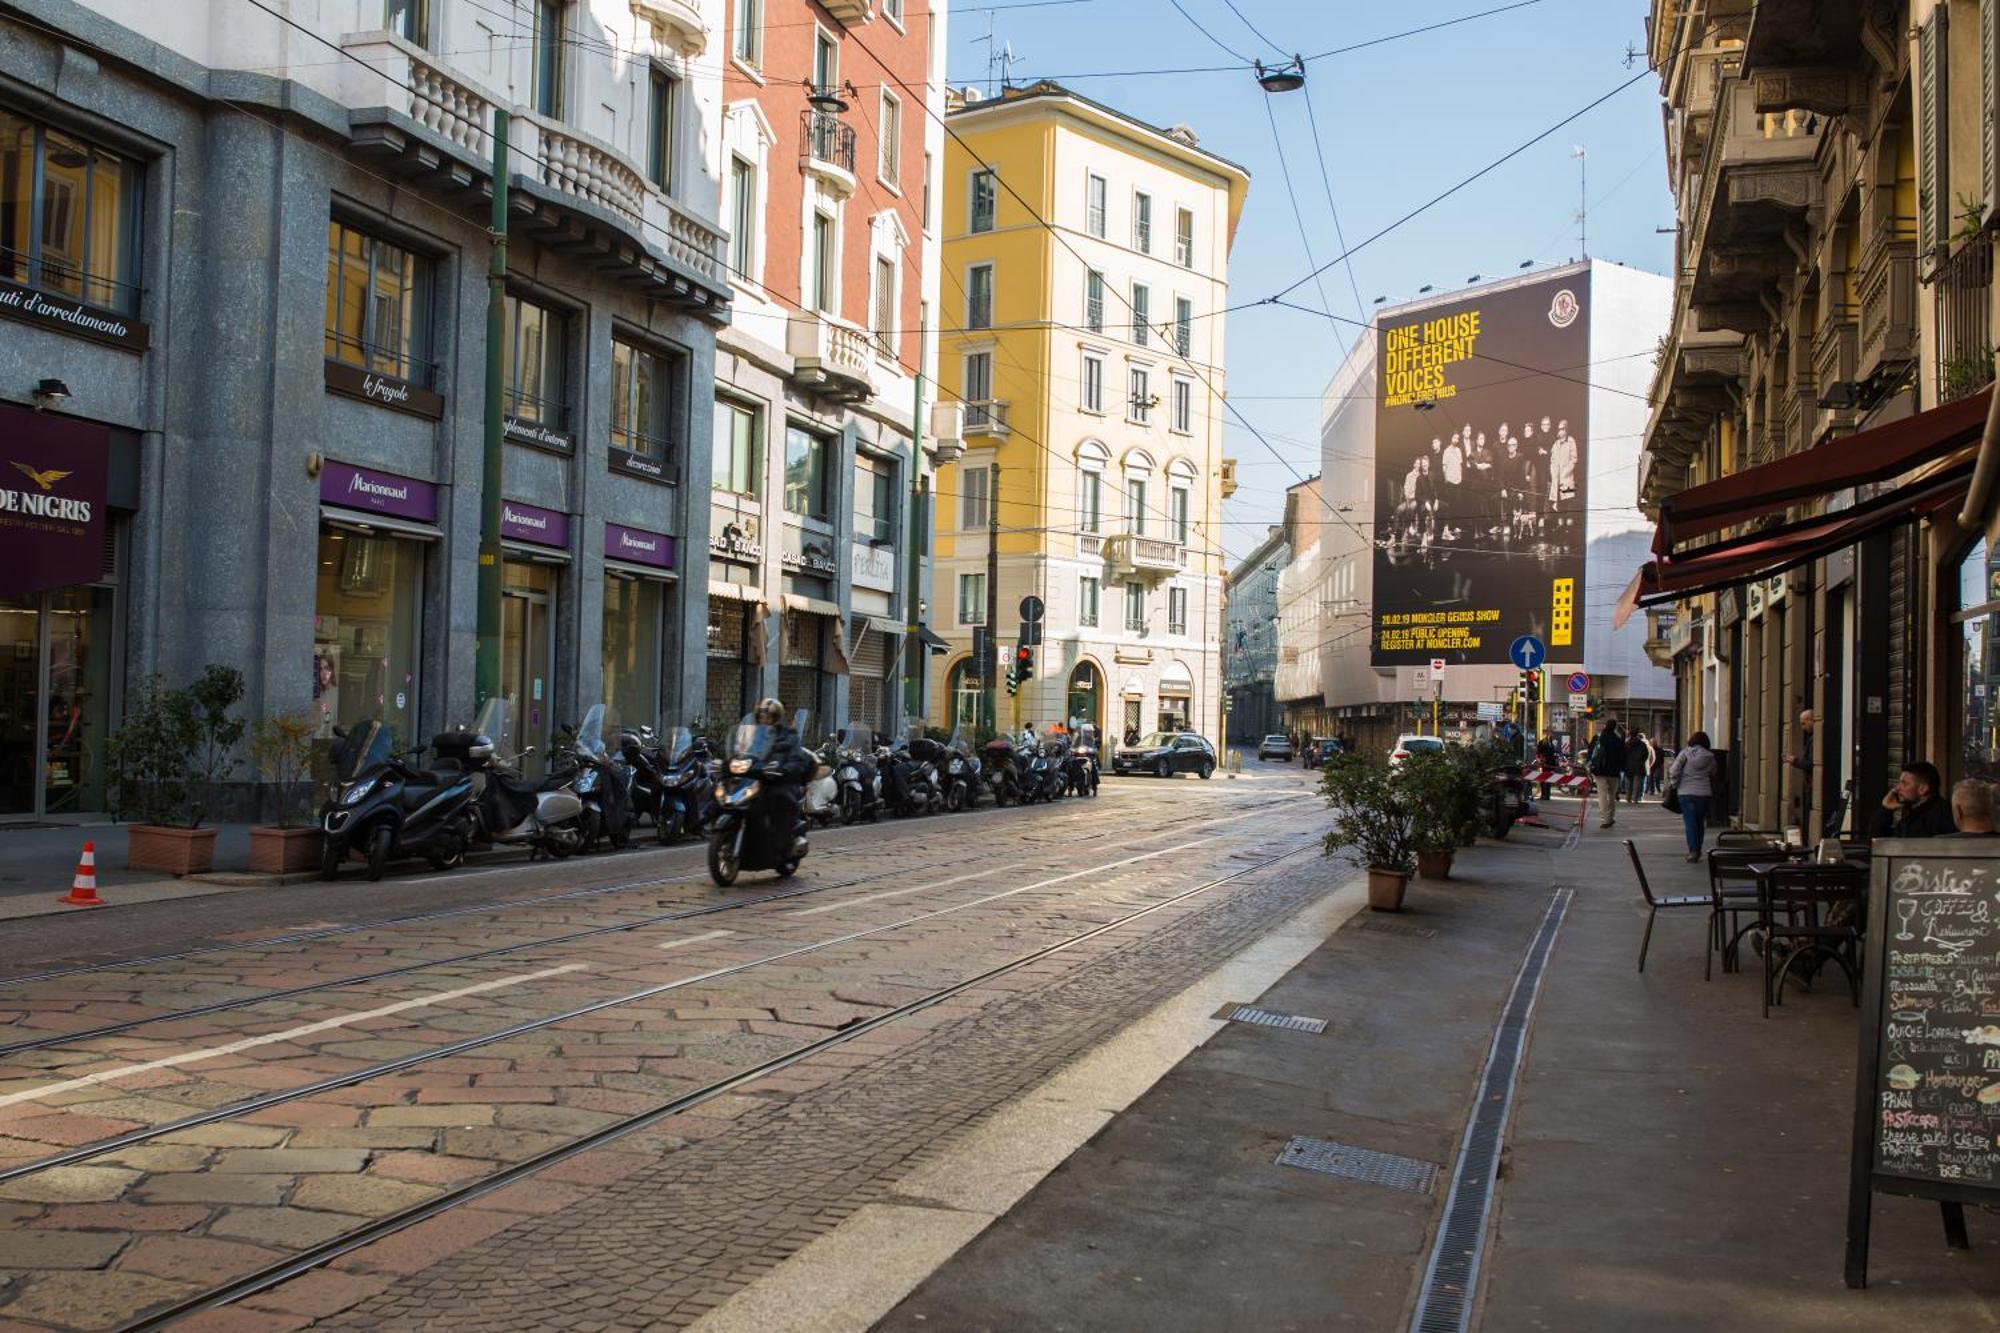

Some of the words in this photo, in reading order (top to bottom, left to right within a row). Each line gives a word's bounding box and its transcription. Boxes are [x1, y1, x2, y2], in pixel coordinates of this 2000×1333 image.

[24, 292, 128, 337] d'arredamento
[1386, 325, 1420, 351] ONE
[1423, 311, 1480, 344] HOUSE
[1386, 335, 1476, 373] DIFFERENT
[367, 378, 409, 401] fragole
[1386, 365, 1445, 395] VOICES
[503, 418, 537, 438] plementi
[348, 472, 407, 500] Marionnaud
[22, 491, 91, 522] NIGRIS
[501, 506, 546, 529] Marionnaud
[620, 532, 660, 554] Marionnaud
[1411, 612, 1446, 624] MONCLER
[1476, 609, 1500, 621] SHOW
[1381, 639, 1414, 650] REGISTER
[1415, 639, 1425, 649] AT
[1427, 637, 1480, 649] MONCLER.COM
[1411, 628, 1436, 639] PUBLIC
[1438, 627, 1470, 638] OPENING
[1925, 1070, 1989, 1097] Hamburger
